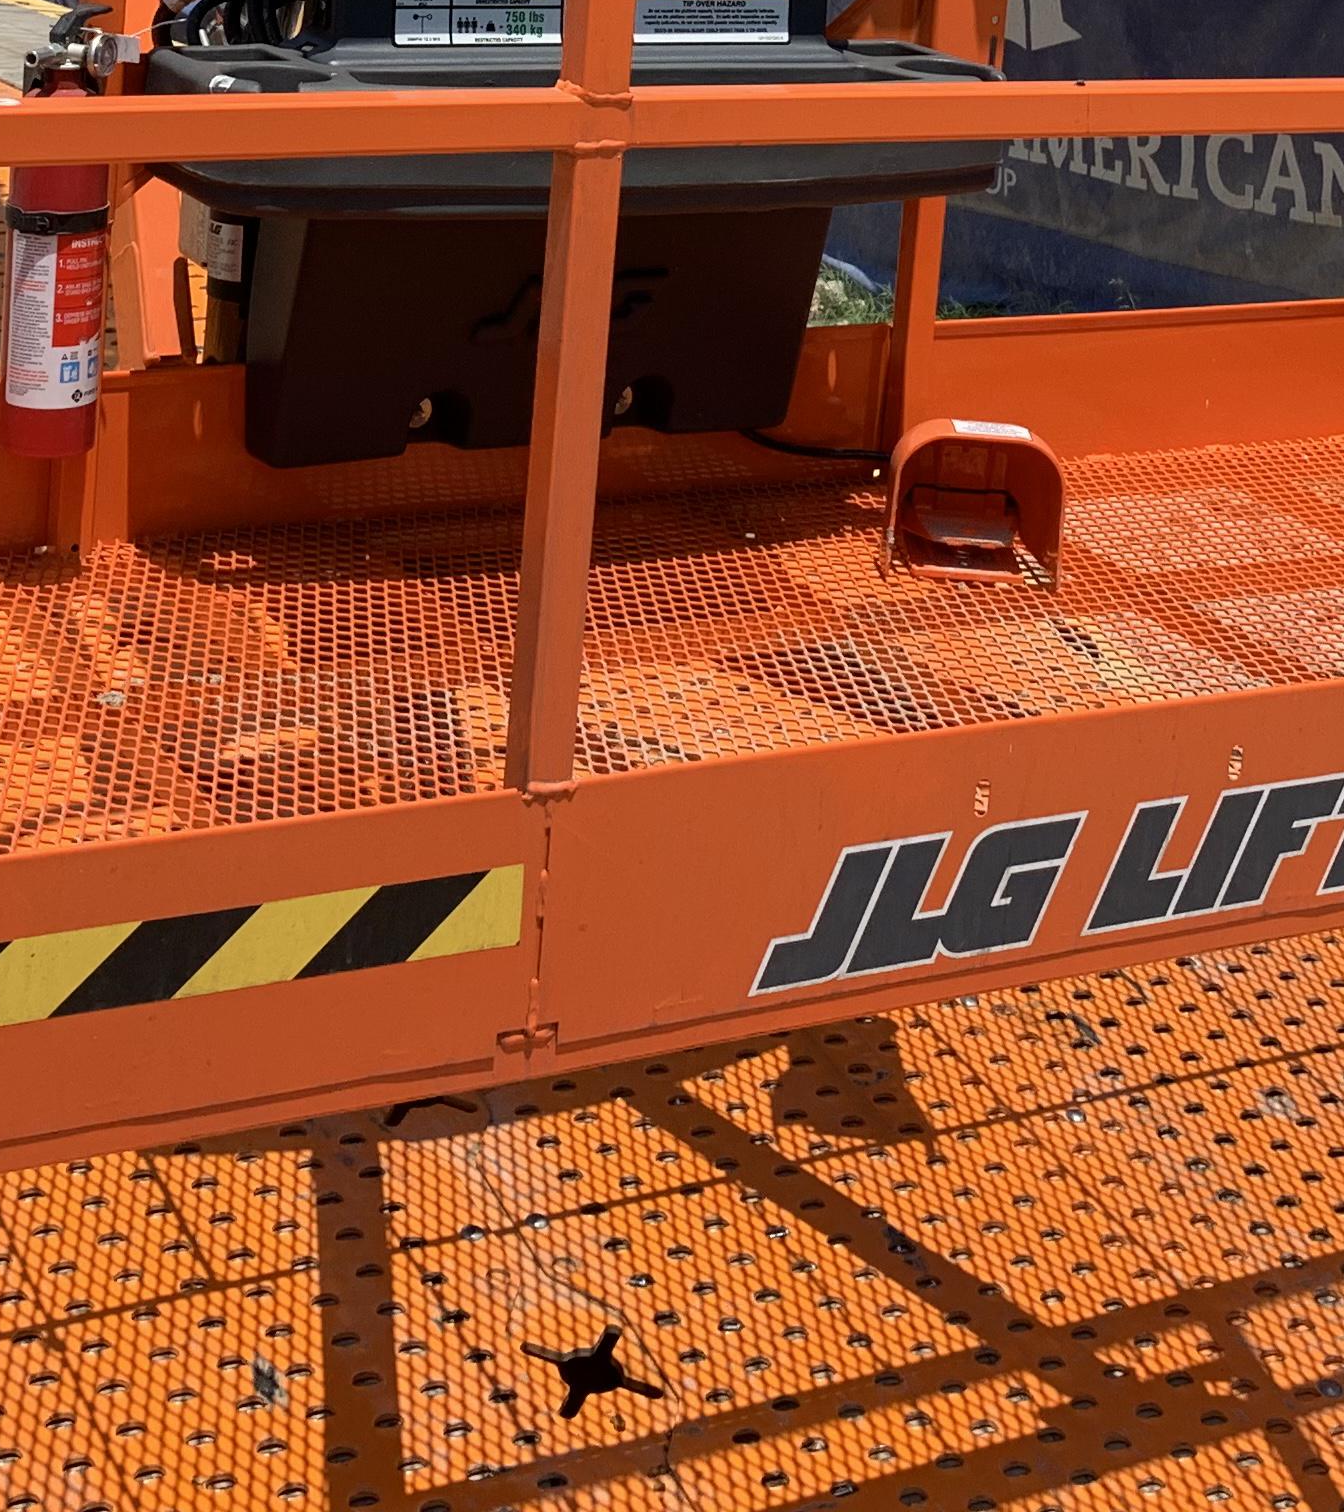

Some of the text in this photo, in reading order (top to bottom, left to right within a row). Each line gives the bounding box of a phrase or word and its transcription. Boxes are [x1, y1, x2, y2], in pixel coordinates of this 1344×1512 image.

[682, 0, 694, 7] TIP
[505, 10, 545, 23] 750 lbs
[506, 23, 543, 38] 340 kg
[750, 810, 1088, 998] JLG
